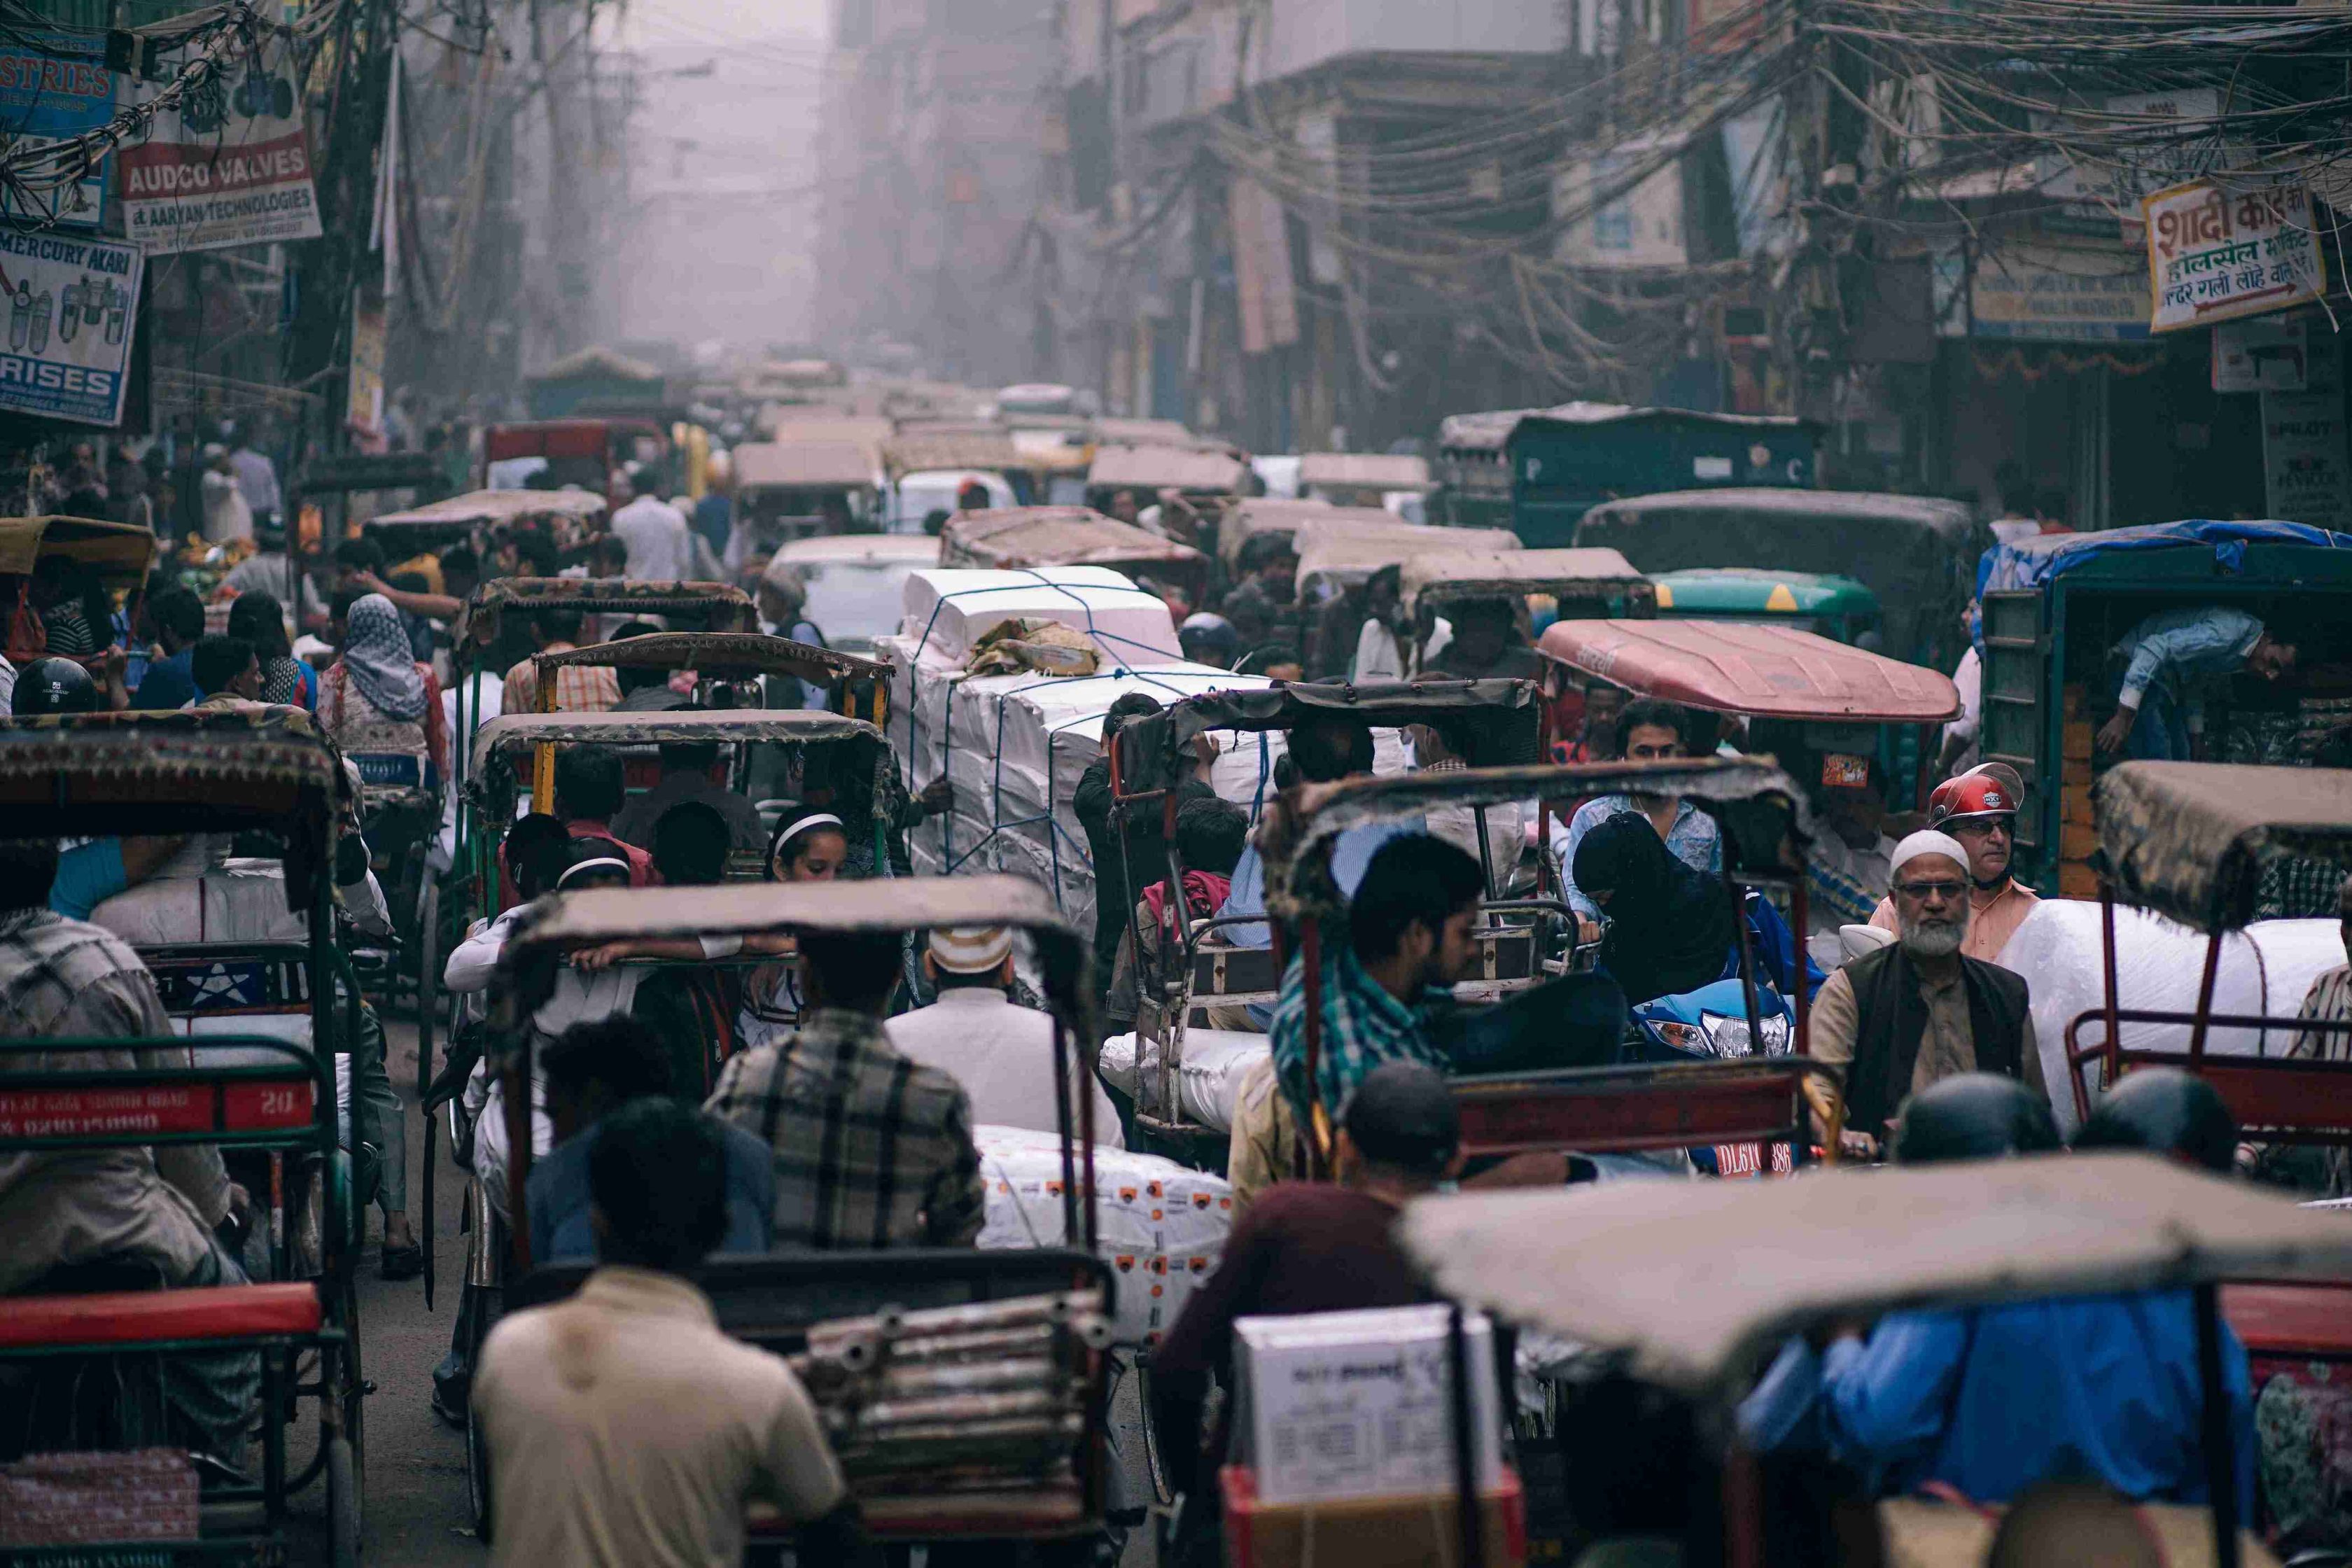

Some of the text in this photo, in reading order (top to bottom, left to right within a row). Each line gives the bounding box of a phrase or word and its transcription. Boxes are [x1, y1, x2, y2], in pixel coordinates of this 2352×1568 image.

[129, 146, 304, 192] AUDCO VALVES
[150, 203, 204, 227] AARYAN
[206, 187, 312, 220] TECHNOLOGIES
[2157, 188, 2232, 260] शादी
[0, 232, 131, 275] MERCURY AKARI
[2197, 270, 2230, 298] गली
[1, 356, 113, 395] RISES
[1526, 458, 1541, 480] P
[1786, 458, 1802, 482] C
